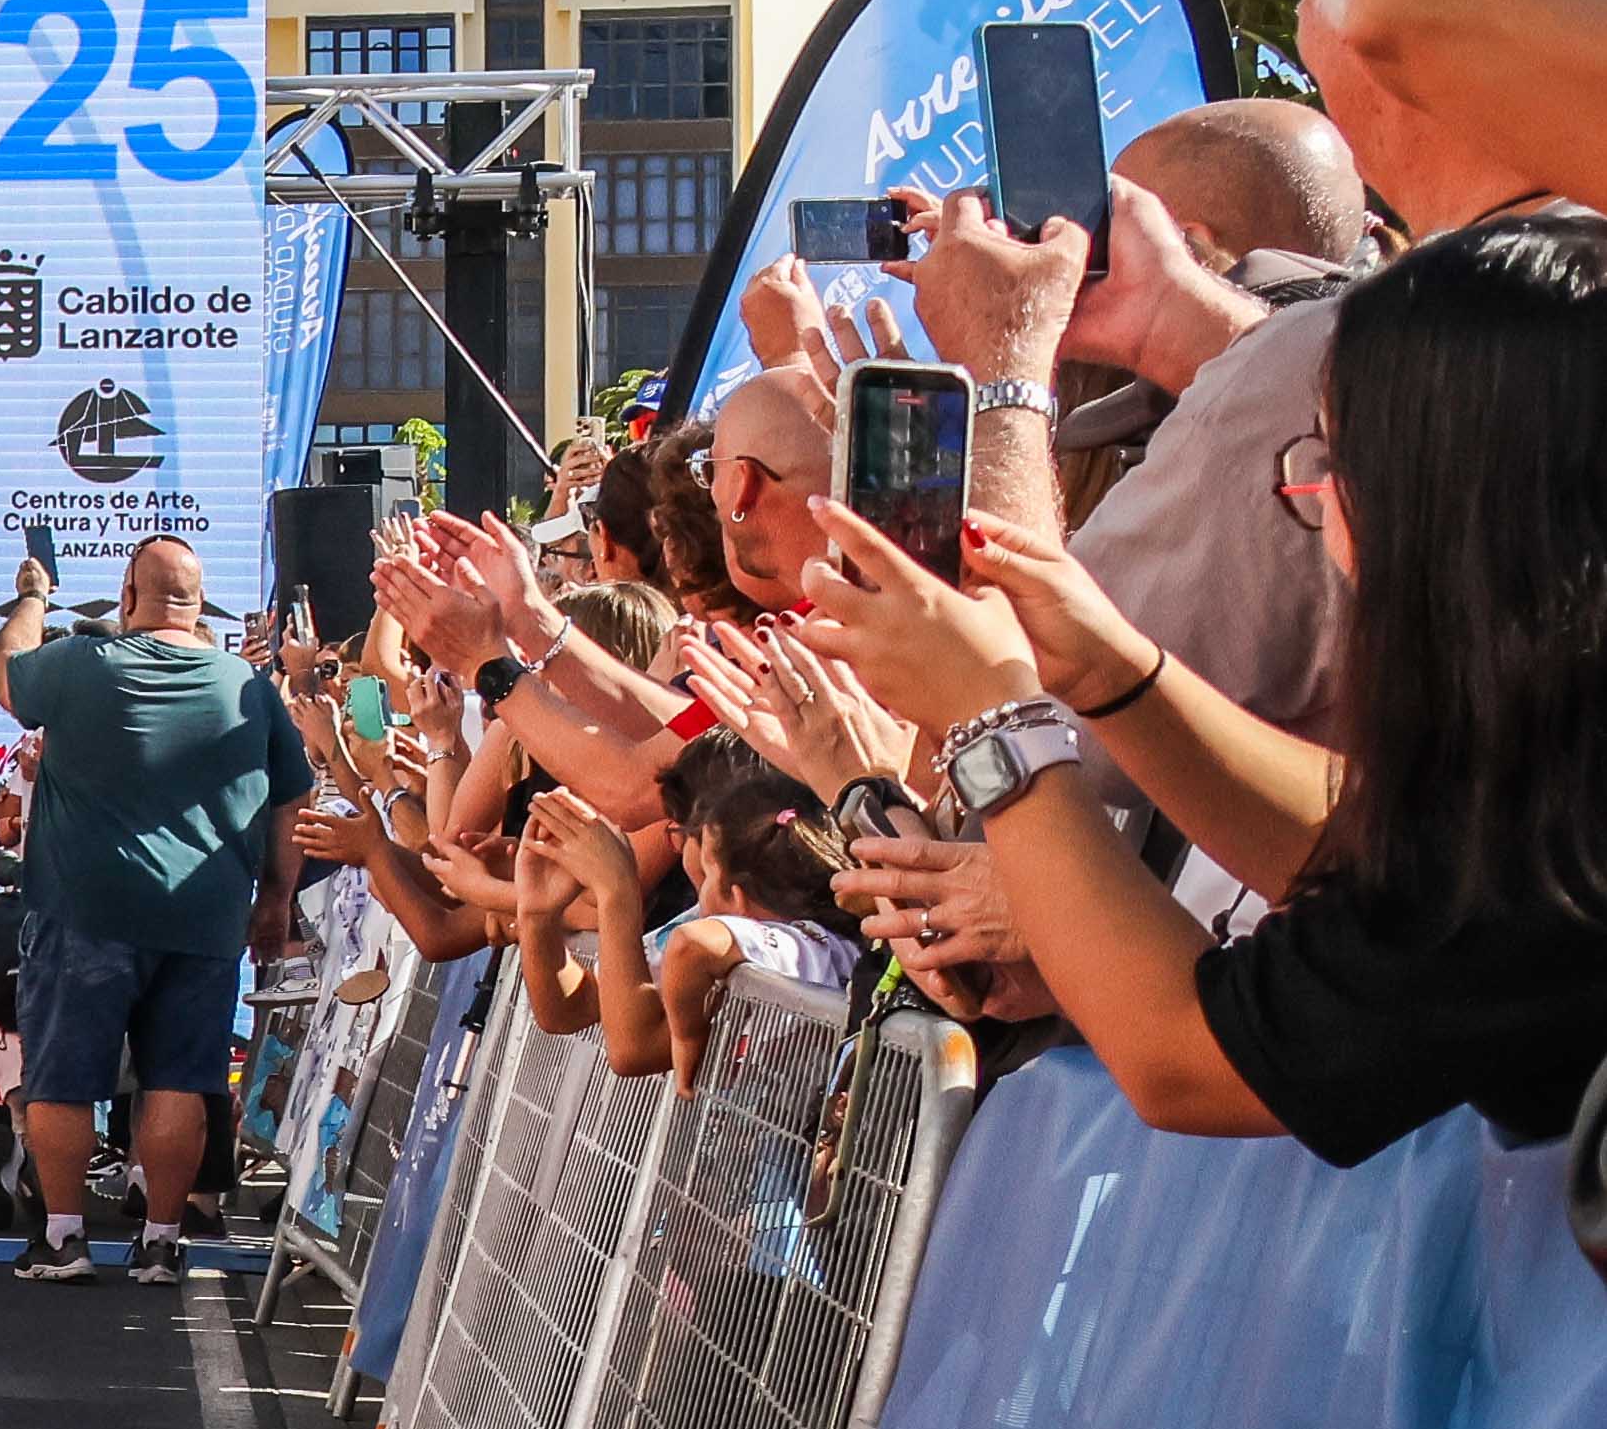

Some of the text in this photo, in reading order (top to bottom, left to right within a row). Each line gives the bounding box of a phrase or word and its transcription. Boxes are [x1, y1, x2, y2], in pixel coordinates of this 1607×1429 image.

[57, 284, 252, 315] Cabildo de
[58, 321, 239, 350] Lanzarote
[10, 489, 201, 513] Centros de Arte,
[3, 512, 210, 538] Cultura y Turismo
[54, 542, 136, 558] LANZARO
